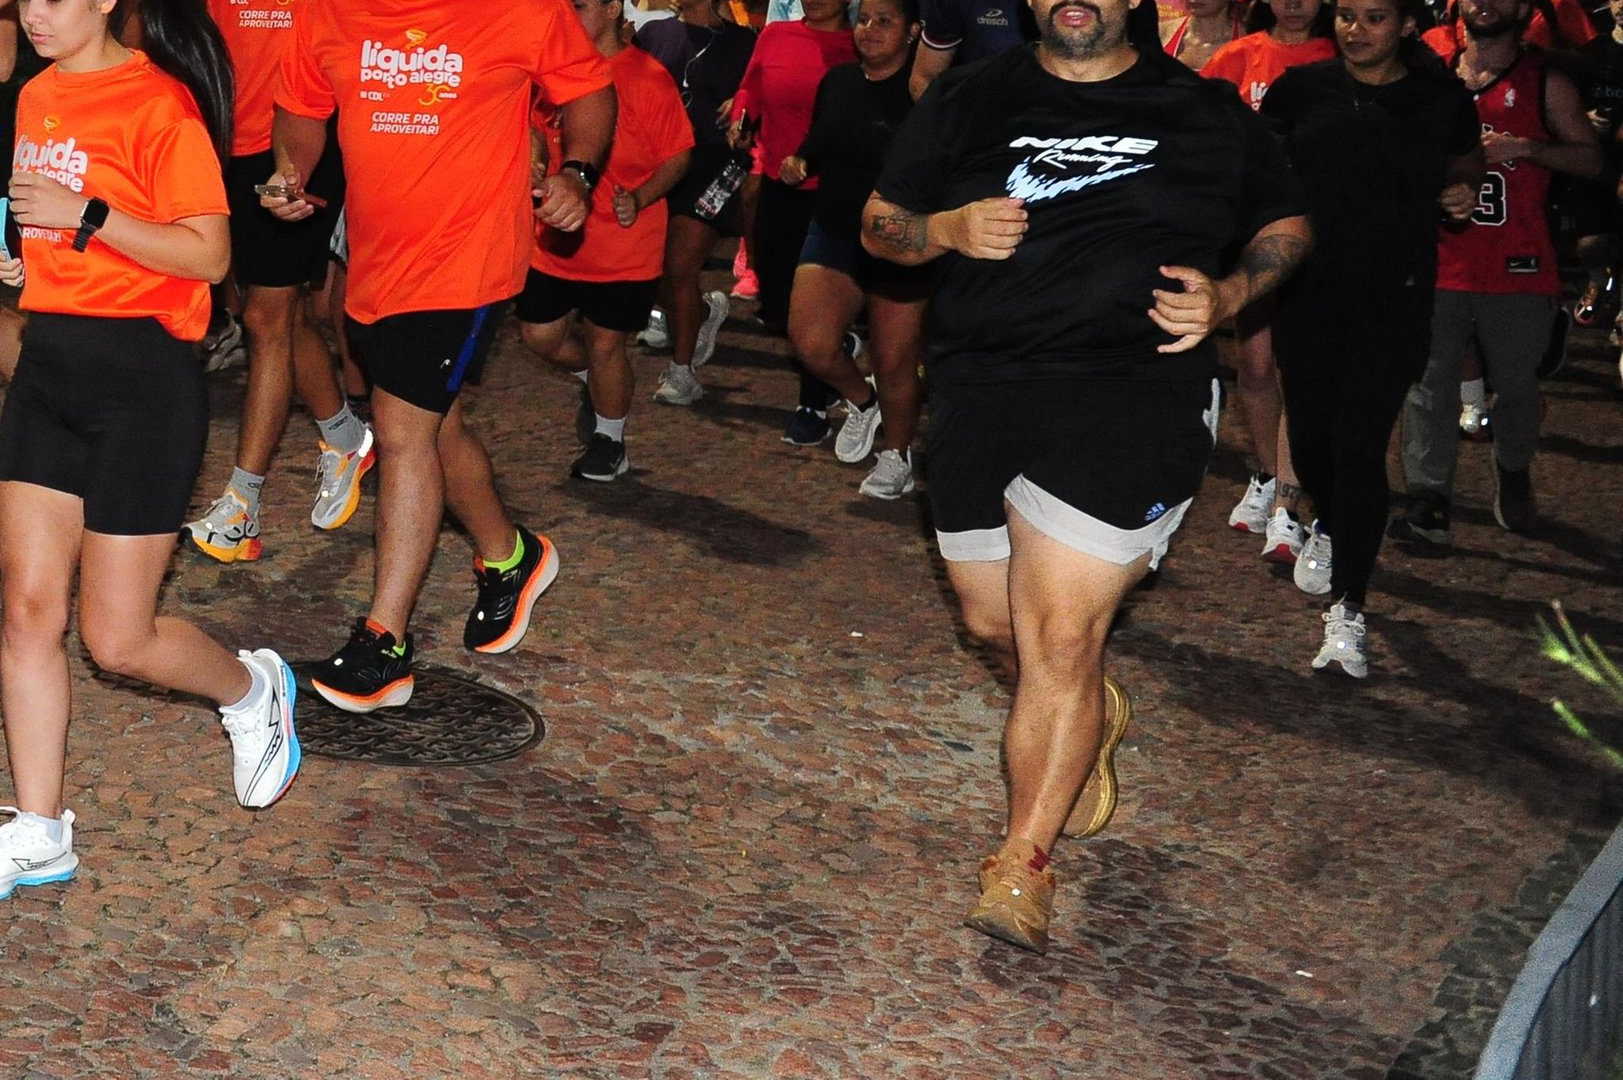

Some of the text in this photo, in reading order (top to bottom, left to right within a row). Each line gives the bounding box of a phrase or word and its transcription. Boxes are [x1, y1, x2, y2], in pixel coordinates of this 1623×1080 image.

[239, 10, 292, 20] CORRE PRA
[238, 19, 293, 28] APROVEITAR!
[360, 39, 464, 76] liquida
[360, 68, 461, 89] porto alegre
[372, 112, 439, 124] CORRE PRA
[370, 123, 440, 135] APROVEITAR!
[1009, 136, 1159, 155] NIKE
[1032, 148, 1134, 173] Running
